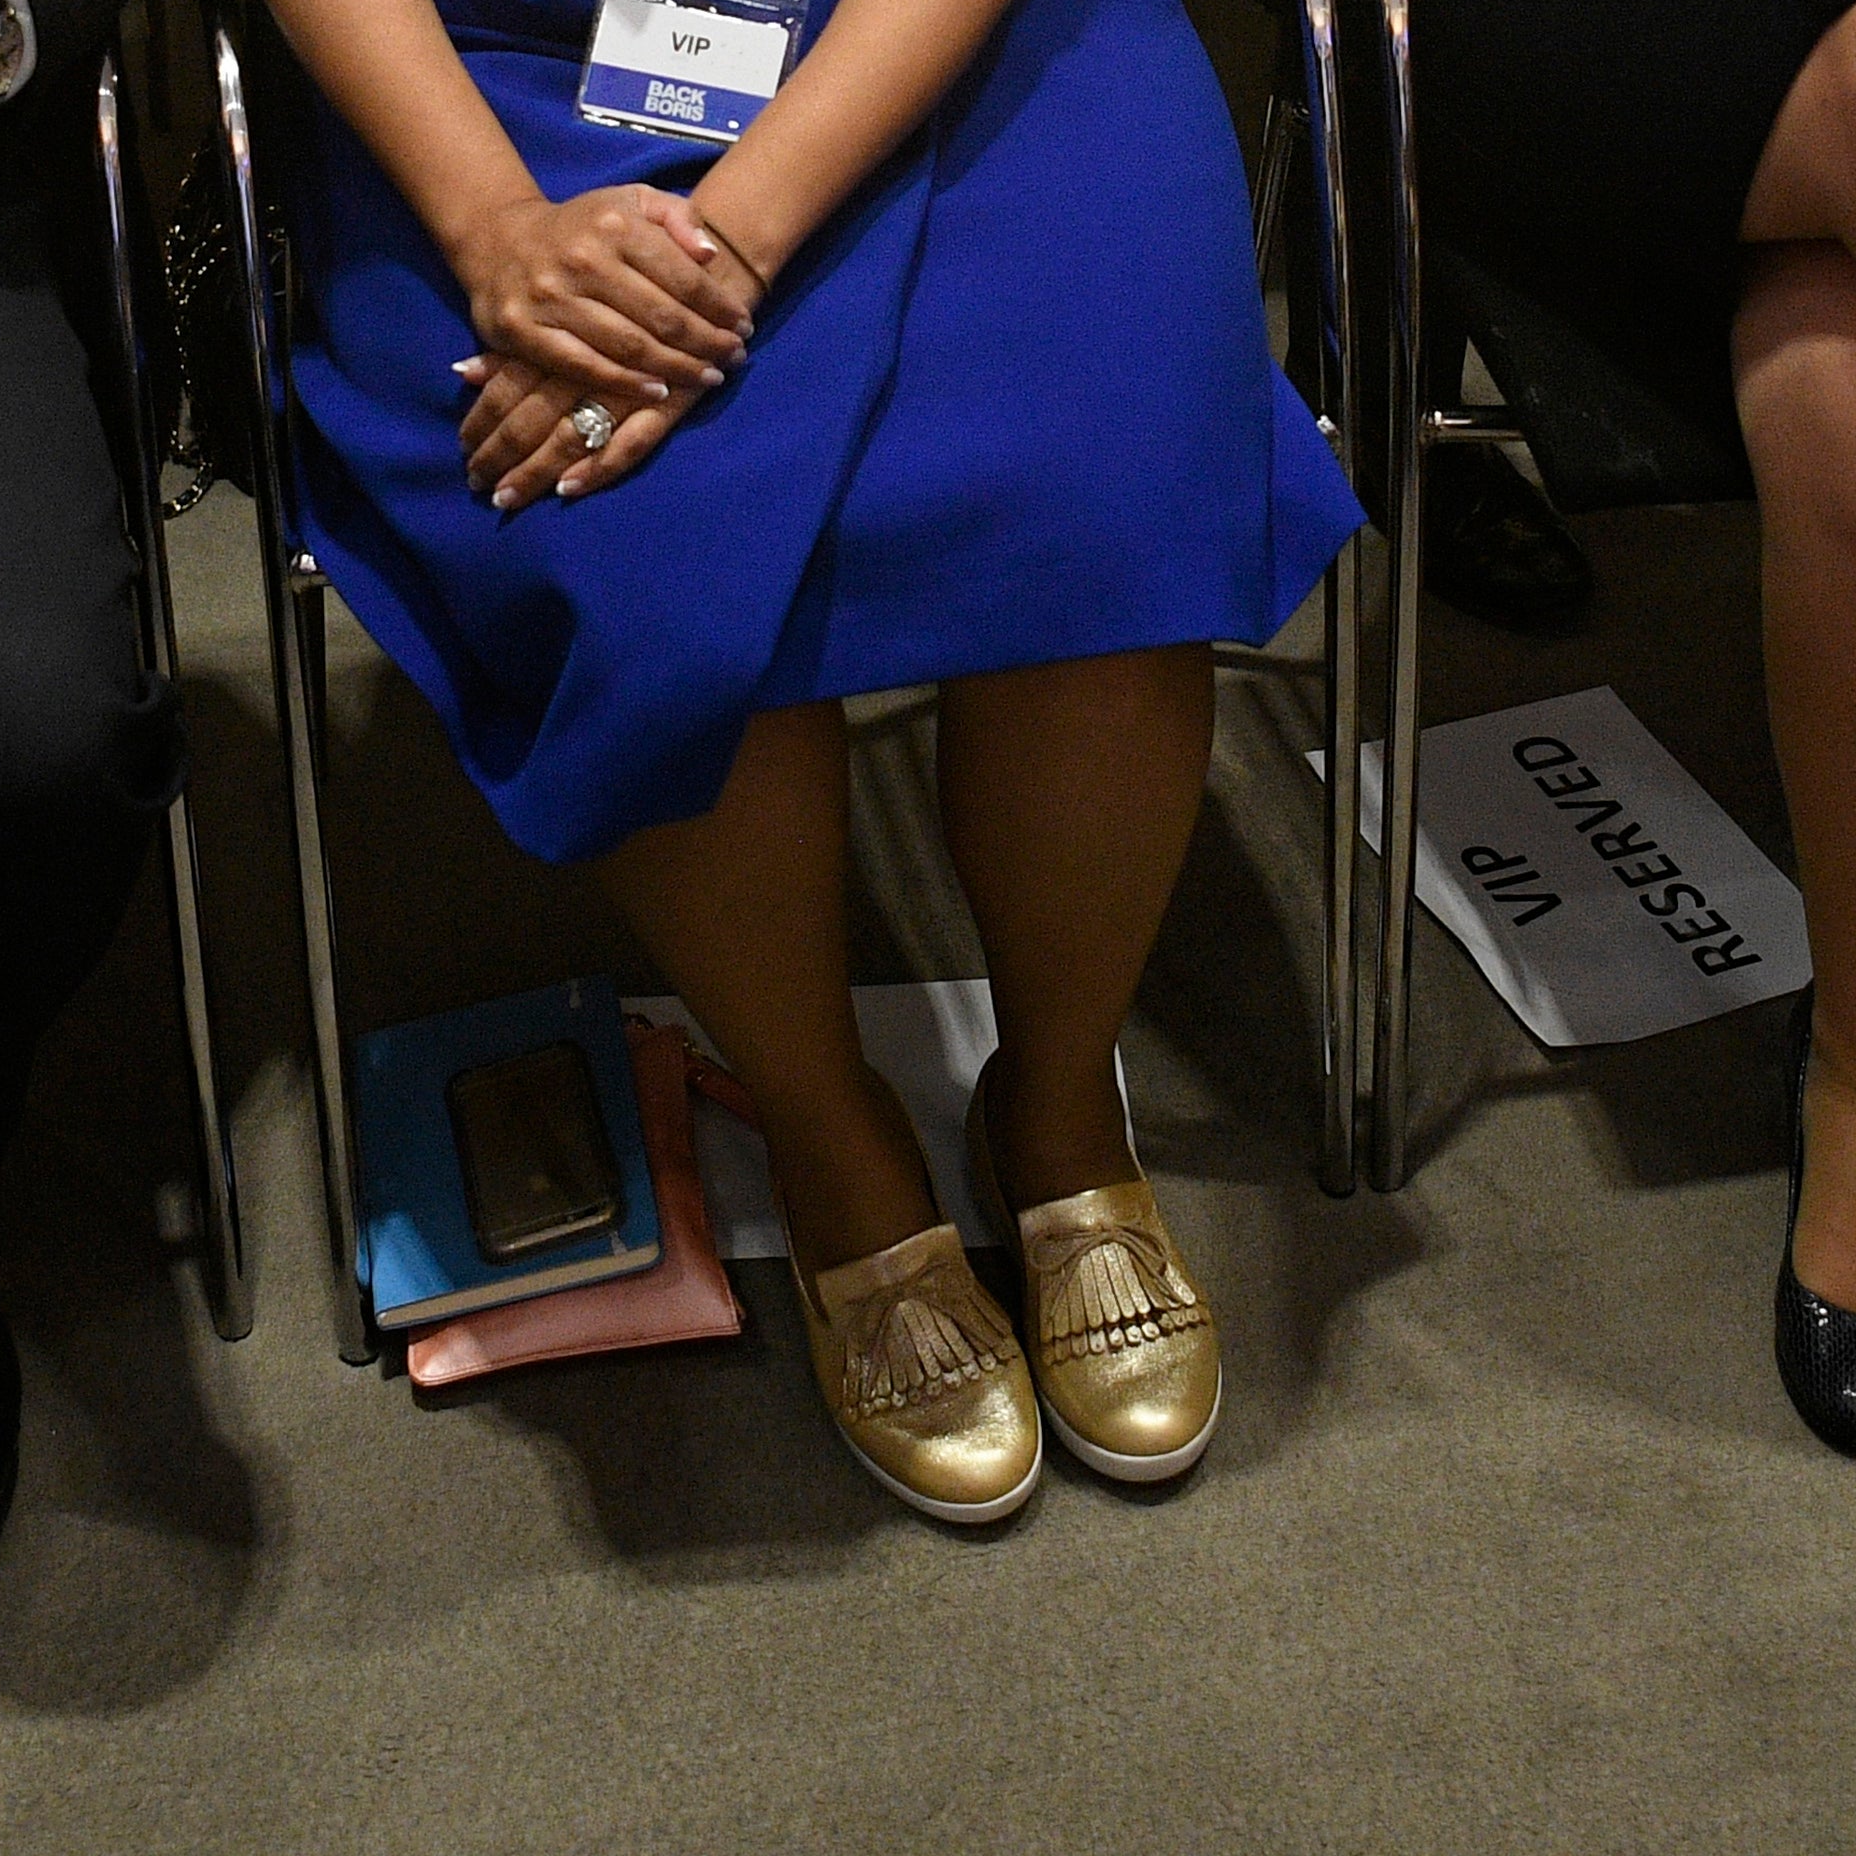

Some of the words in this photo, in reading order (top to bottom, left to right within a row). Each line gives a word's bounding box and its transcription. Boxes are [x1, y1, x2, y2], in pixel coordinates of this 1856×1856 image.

[671, 30, 711, 56] VIP
[647, 79, 707, 105] BACK
[644, 95, 704, 122] BORIS
[1511, 735, 1764, 977] RESERVED
[1460, 845, 1563, 928] VIP
